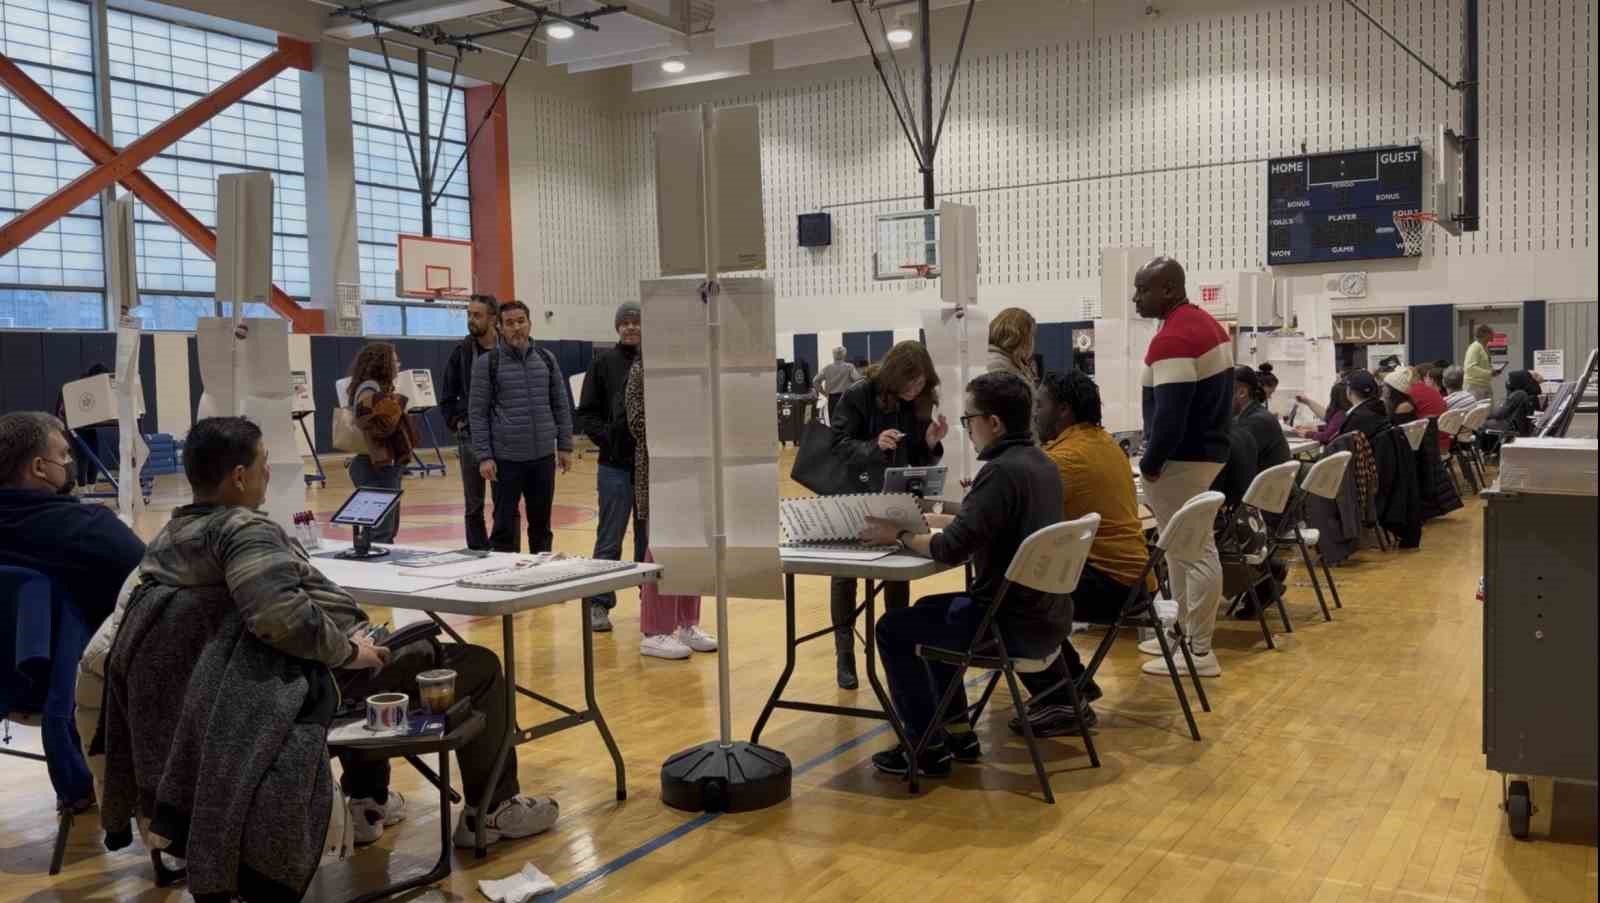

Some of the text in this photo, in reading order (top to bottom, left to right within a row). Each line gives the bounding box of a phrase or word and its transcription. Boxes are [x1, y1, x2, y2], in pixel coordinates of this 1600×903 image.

[1380, 151, 1418, 164] GUEST
[1271, 161, 1304, 174] HOME
[1376, 193, 1400, 201] BONUS
[1287, 200, 1311, 208] BONUS
[1328, 214, 1357, 222] PLAYER
[1331, 246, 1355, 254] GAME
[1332, 317, 1395, 340] NIOR
